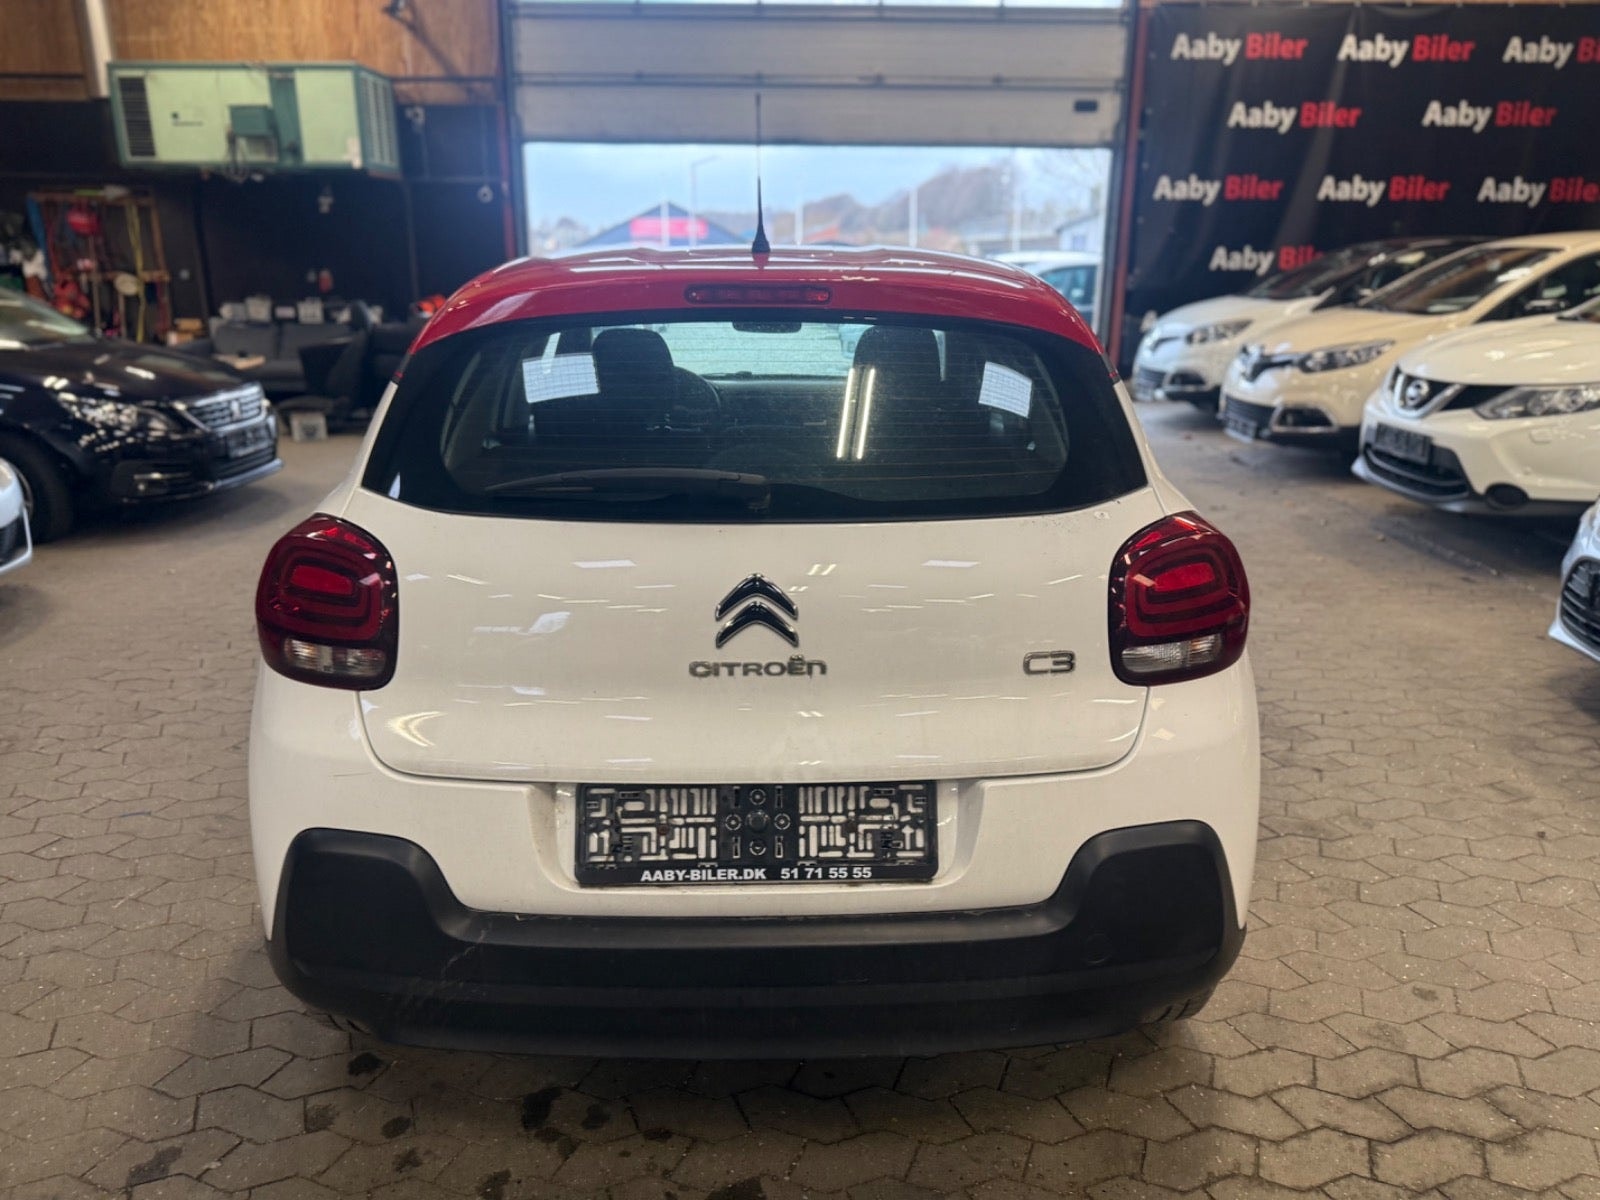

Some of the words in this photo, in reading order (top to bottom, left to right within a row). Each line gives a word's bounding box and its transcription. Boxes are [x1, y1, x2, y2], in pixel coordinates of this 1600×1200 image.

[1170, 31, 1242, 66] Aaby
[1245, 32, 1308, 60] Biler
[1337, 33, 1409, 68] Aaby
[1412, 34, 1475, 62] Biler
[1502, 35, 1574, 70] Aaby
[1227, 100, 1297, 134] Aaby
[1300, 101, 1361, 128] Biler
[1421, 99, 1492, 133] Aaby
[1495, 101, 1557, 127] Biler
[1152, 173, 1221, 206] Aaby
[1224, 174, 1283, 201] Biler
[1316, 174, 1386, 207] Aaby
[1388, 175, 1450, 201] Biler
[1477, 175, 1546, 207] Aaby
[1549, 176, 1600, 203] Bile
[1209, 245, 1275, 276] Aaby
[1278, 245, 1324, 271] Bil
[1023, 650, 1075, 675] C3
[640, 868, 767, 882] AABY-BILER.DK
[780, 868, 799, 879] 51
[804, 867, 823, 879] 71
[828, 867, 848, 879] 55
[852, 867, 872, 879] 55
